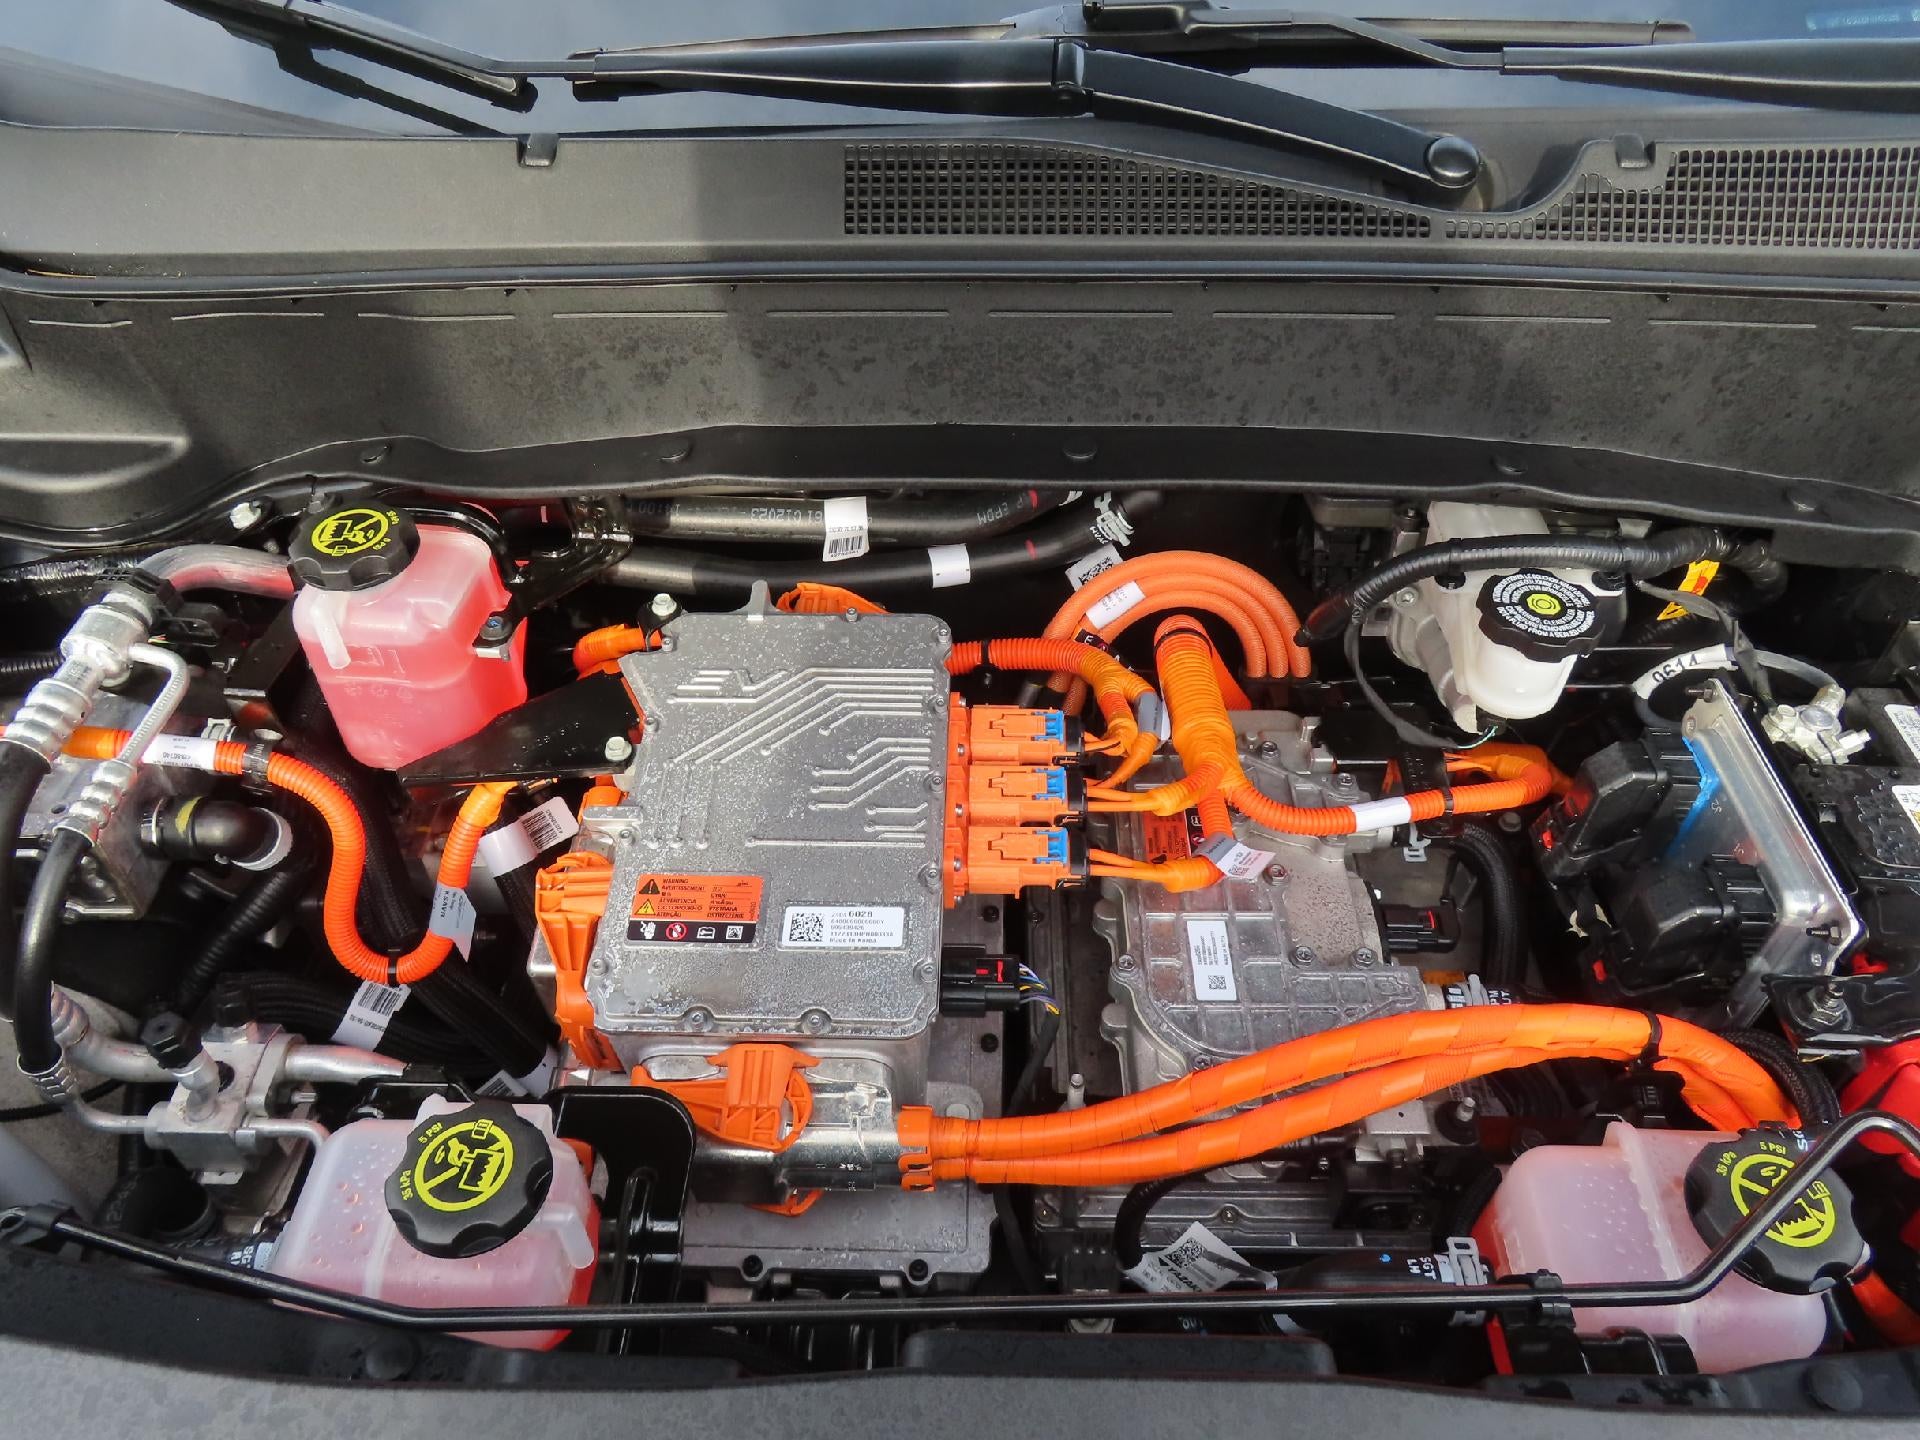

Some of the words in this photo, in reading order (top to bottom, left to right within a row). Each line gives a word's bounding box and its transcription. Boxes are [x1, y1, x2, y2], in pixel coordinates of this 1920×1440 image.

[1527, 627, 1549, 637] FROM
[418, 1134, 428, 1144] 5
[428, 1122, 443, 1138] PSI
[1759, 1141, 1767, 1150] 5
[1769, 1142, 1787, 1155] PSI
[1719, 1151, 1737, 1166] kPa
[1715, 1163, 1728, 1177] 35
[401, 1189, 414, 1201] 35
[1406, 1259, 1421, 1274] LH
[1419, 1256, 1437, 1280] SGT
